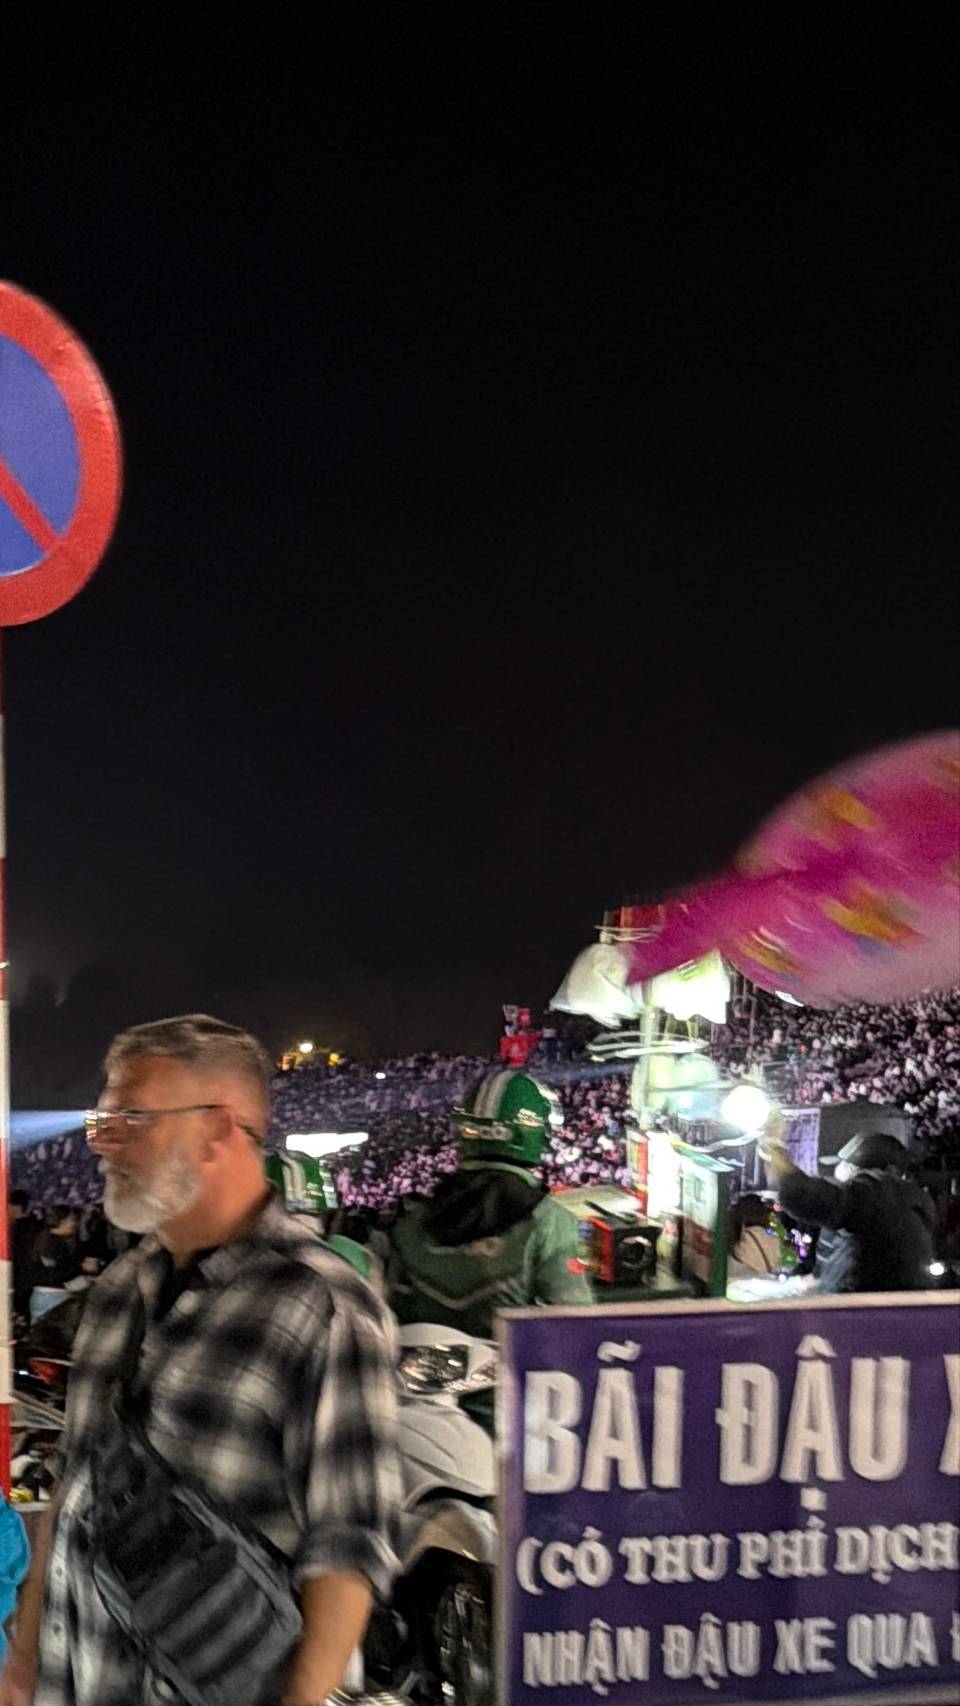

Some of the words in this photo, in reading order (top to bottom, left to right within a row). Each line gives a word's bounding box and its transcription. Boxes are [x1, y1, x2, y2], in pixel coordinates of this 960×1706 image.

[523, 1339, 685, 1494] BÃI
[715, 1334, 911, 1511] ĐẬU
[618, 1533, 731, 1585] THU
[834, 1522, 959, 1584] DỊCH
[523, 1617, 650, 1695] NHẬN
[661, 1612, 760, 1690] ĐẬU
[773, 1617, 836, 1674] XE
[847, 1611, 939, 1678] QUA
